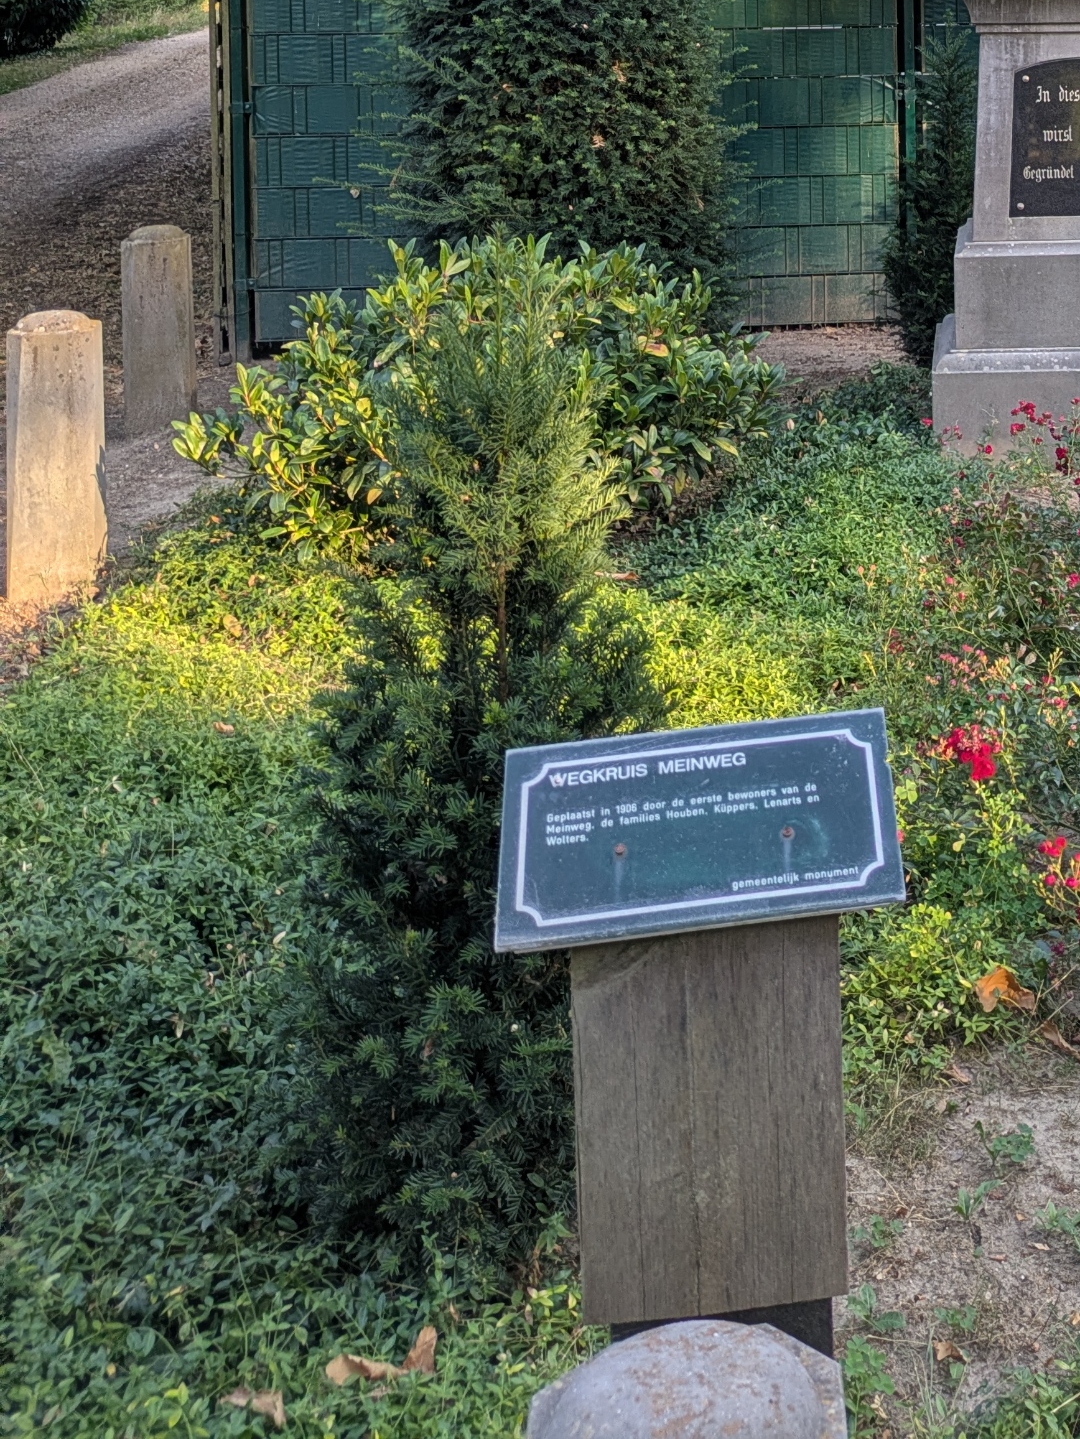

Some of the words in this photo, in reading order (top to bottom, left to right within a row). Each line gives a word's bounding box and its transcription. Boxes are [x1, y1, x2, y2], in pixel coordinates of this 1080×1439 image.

[1035, 85, 1051, 103] In
[1042, 125, 1073, 143] wirst
[1023, 165, 1074, 183] Gegründet
[549, 763, 649, 787] WEGKRUIS
[658, 752, 746, 774] MEINWEG
[546, 809, 595, 824] Geplaatst
[600, 807, 610, 817] in
[615, 803, 637, 814] 1906
[643, 800, 666, 812] door
[672, 797, 685, 808] de
[690, 793, 723, 805] eerste
[728, 788, 777, 801] bewoners
[781, 785, 799, 795] van
[804, 782, 817, 792] de
[600, 817, 614, 828] de
[619, 812, 661, 826] families
[764, 797, 802, 809] Lenarts
[807, 794, 820, 804] en
[546, 833, 590, 847] Wolters.
[732, 872, 800, 891] gemeentelijk
[804, 866, 859, 880] monument
